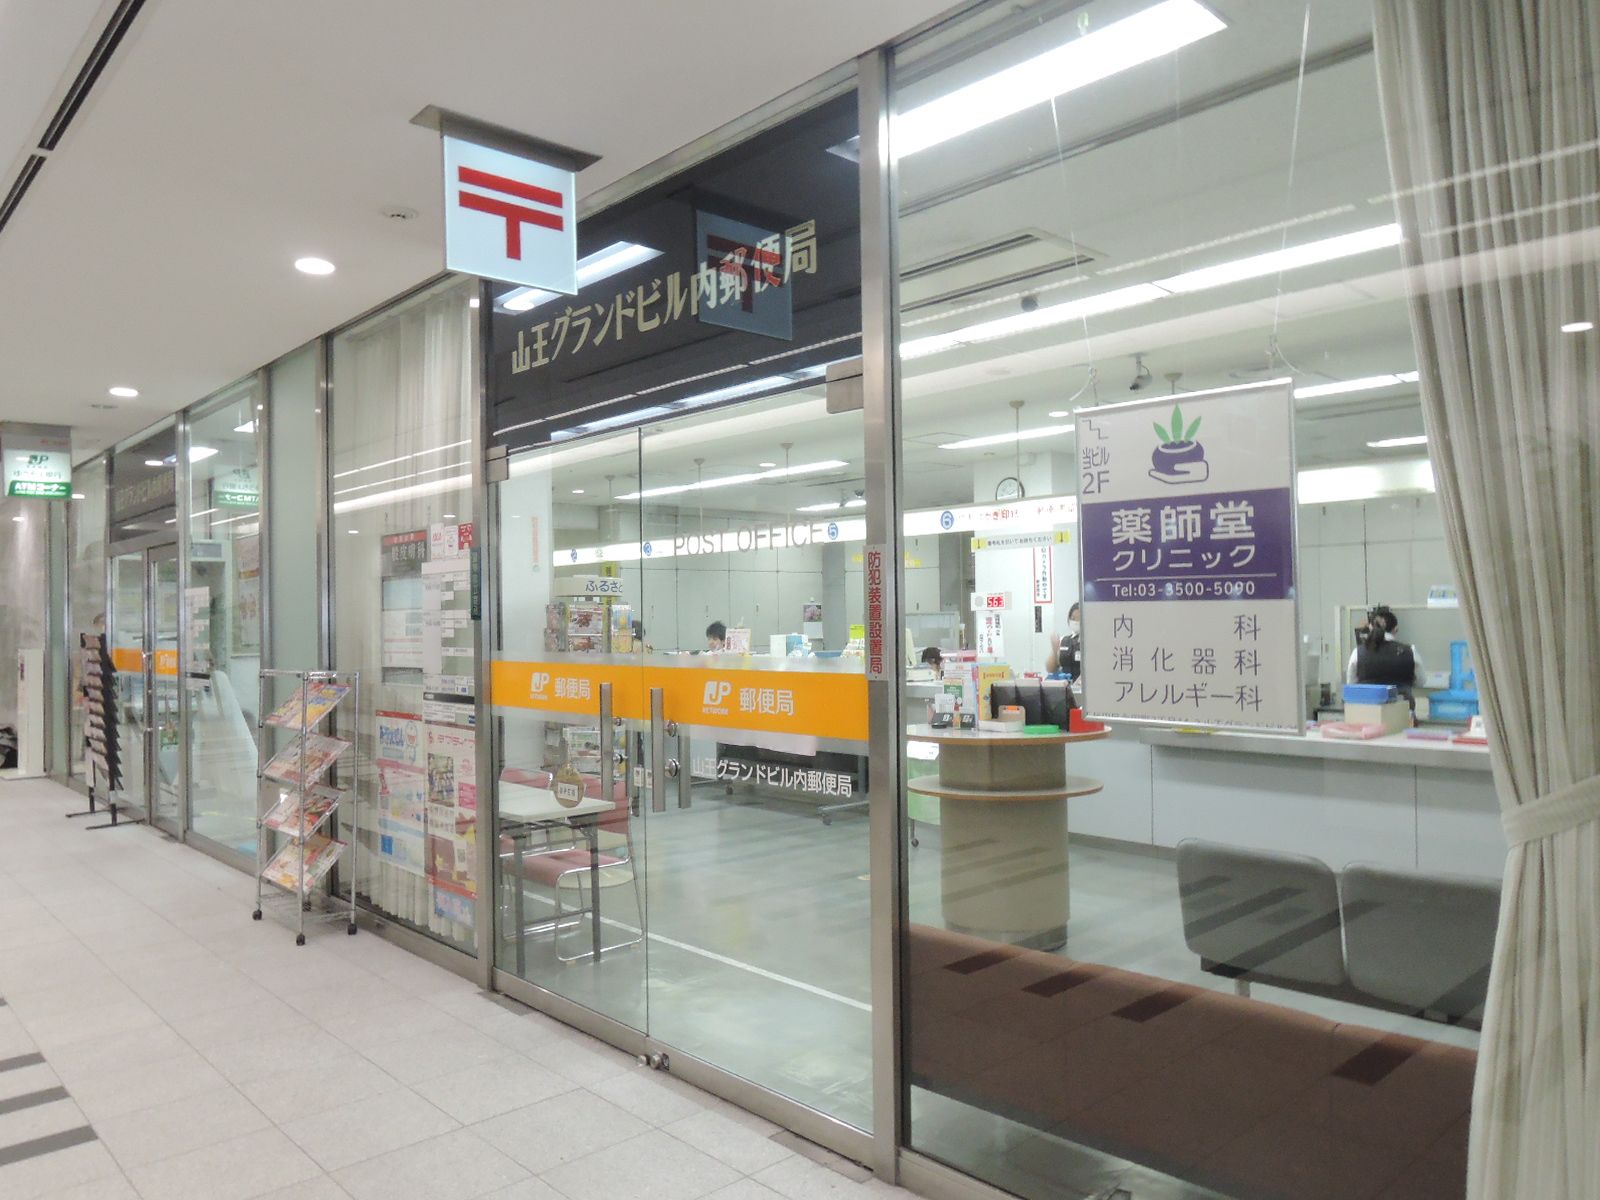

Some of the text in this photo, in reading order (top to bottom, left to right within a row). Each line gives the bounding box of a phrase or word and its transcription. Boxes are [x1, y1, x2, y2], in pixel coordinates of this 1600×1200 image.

[511, 219, 818, 375] 山王グランドビル内郵便局
[1082, 446, 1110, 469] 当ビル
[1082, 471, 1110, 494] 2F
[673, 520, 823, 555] POST OFFICE
[1111, 500, 1255, 545] 薬師堂
[1112, 544, 1255, 572] クリニック
[868, 551, 883, 674] 防犯装置設置局
[555, 677, 591, 700] 郵便局
[739, 687, 794, 716] 郵便局
[1115, 681, 1262, 712] アレルギー科
[692, 758, 852, 798] 山王グランドビル内郵便局
